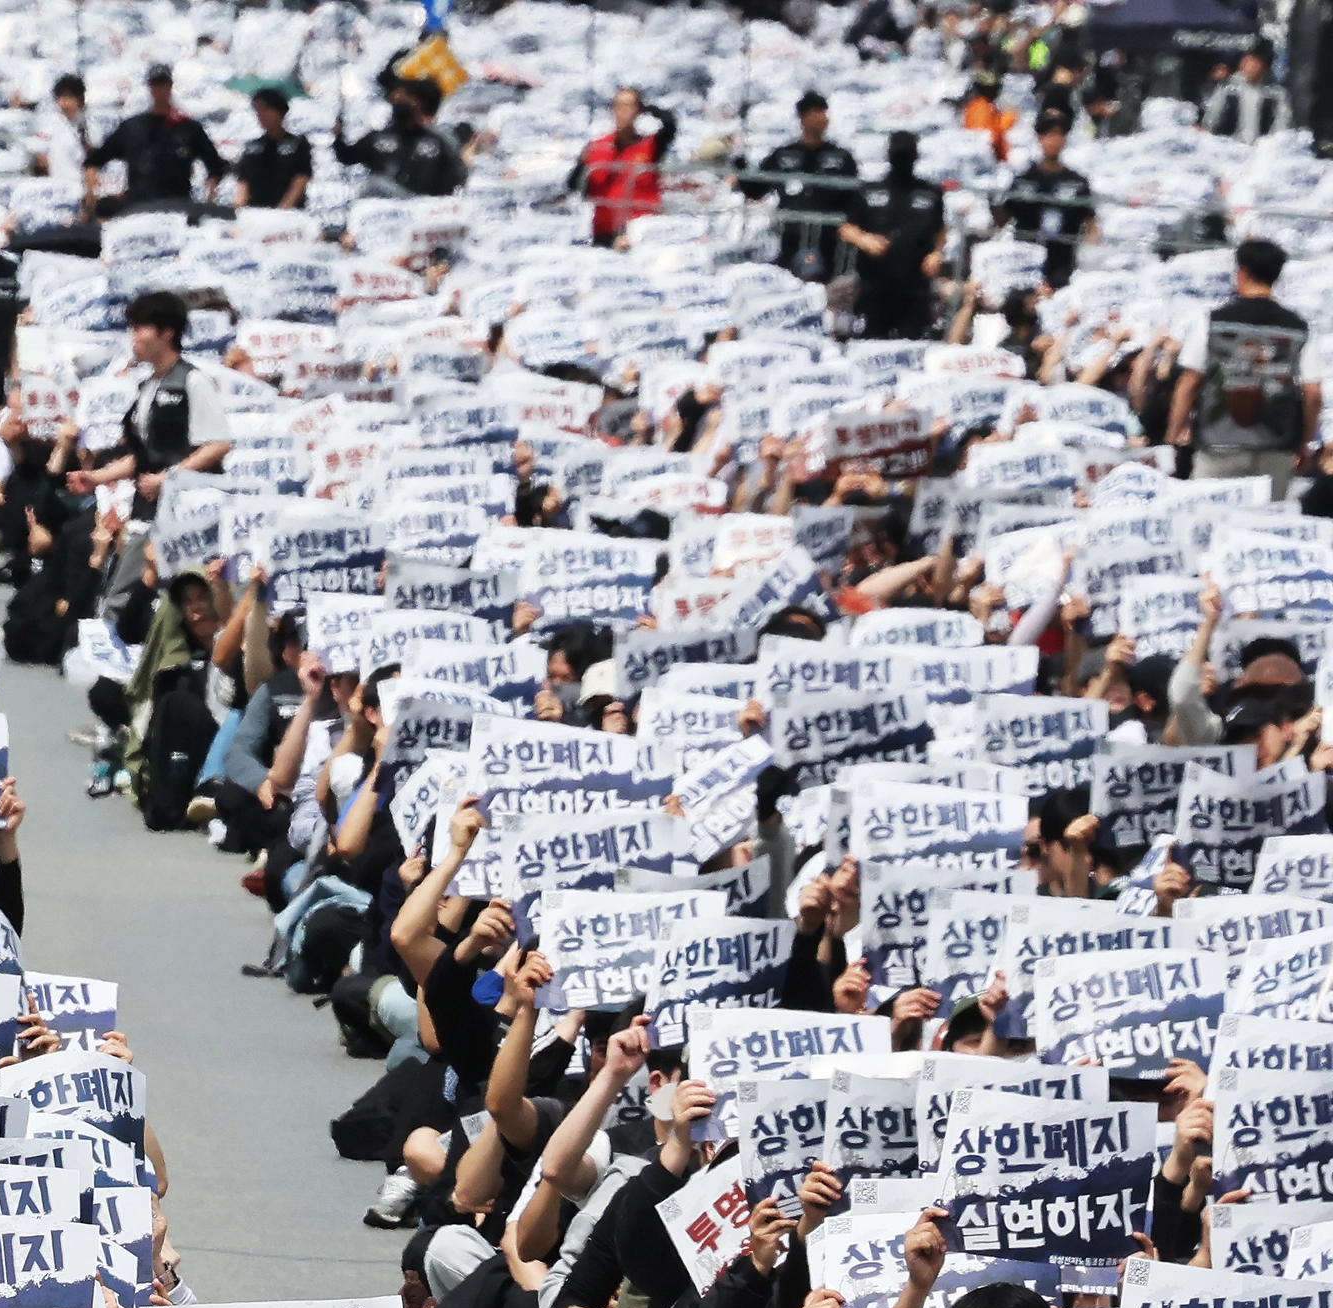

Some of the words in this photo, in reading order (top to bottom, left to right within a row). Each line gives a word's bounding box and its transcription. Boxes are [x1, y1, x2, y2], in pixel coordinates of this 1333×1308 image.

[765, 660, 893, 697] 상한폐지
[783, 695, 910, 751] 상한폐지
[983, 709, 1094, 752] 상한폐지
[481, 739, 615, 776] 상한폐지
[863, 801, 1006, 841] 상한폐지
[1189, 787, 1312, 831] 상한폐지
[513, 823, 652, 879] 상한폐지
[660, 934, 781, 988] 상한폐지
[1047, 958, 1204, 1023] 상한폐지
[703, 1021, 865, 1076] 상한폐지
[952, 1110, 1130, 1176] 상한폐지
[956, 1189, 1148, 1252] 실현하자
